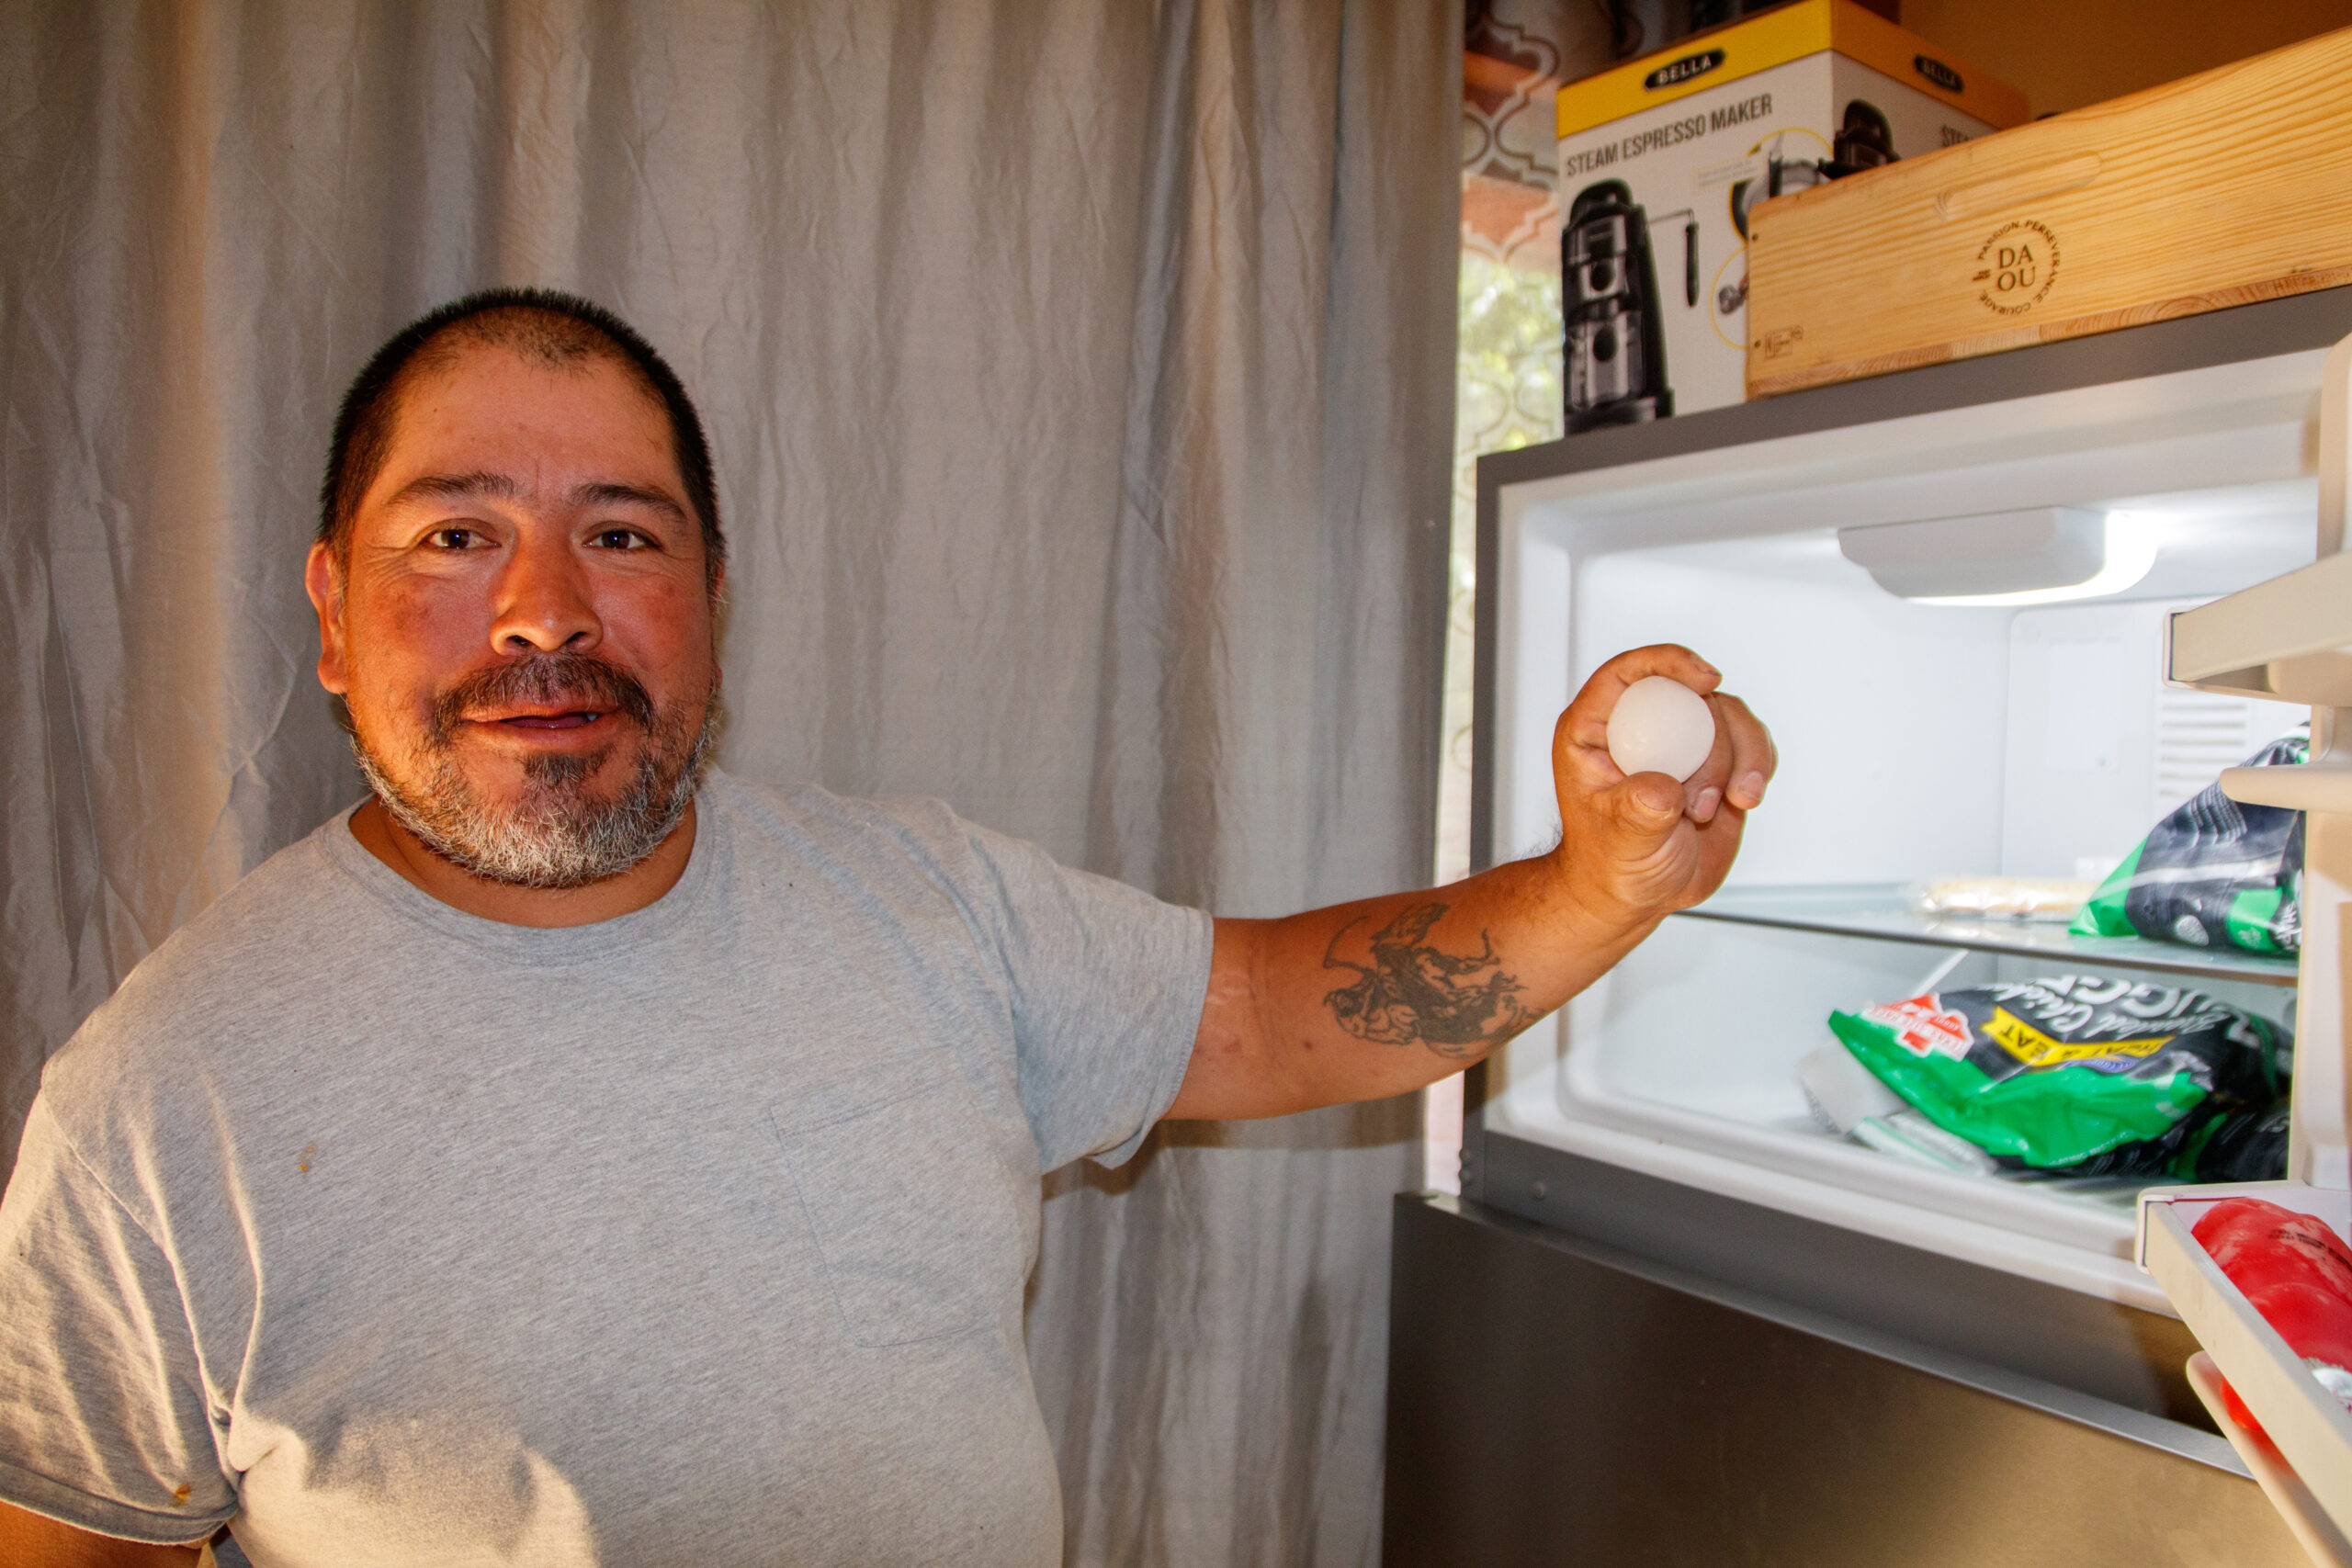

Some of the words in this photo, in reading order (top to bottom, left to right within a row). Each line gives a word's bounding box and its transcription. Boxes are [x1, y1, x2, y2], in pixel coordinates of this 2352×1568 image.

[1657, 55, 1713, 85] BELLA
[1923, 59, 1955, 87] BELLA
[1566, 142, 1618, 176] STEAM
[1623, 113, 1706, 160] ESPRESSO
[1711, 93, 1772, 132] MAKER
[1998, 243, 2033, 269] DA
[1997, 265, 2036, 292] OU
[2000, 1024, 2049, 1059] EAT
